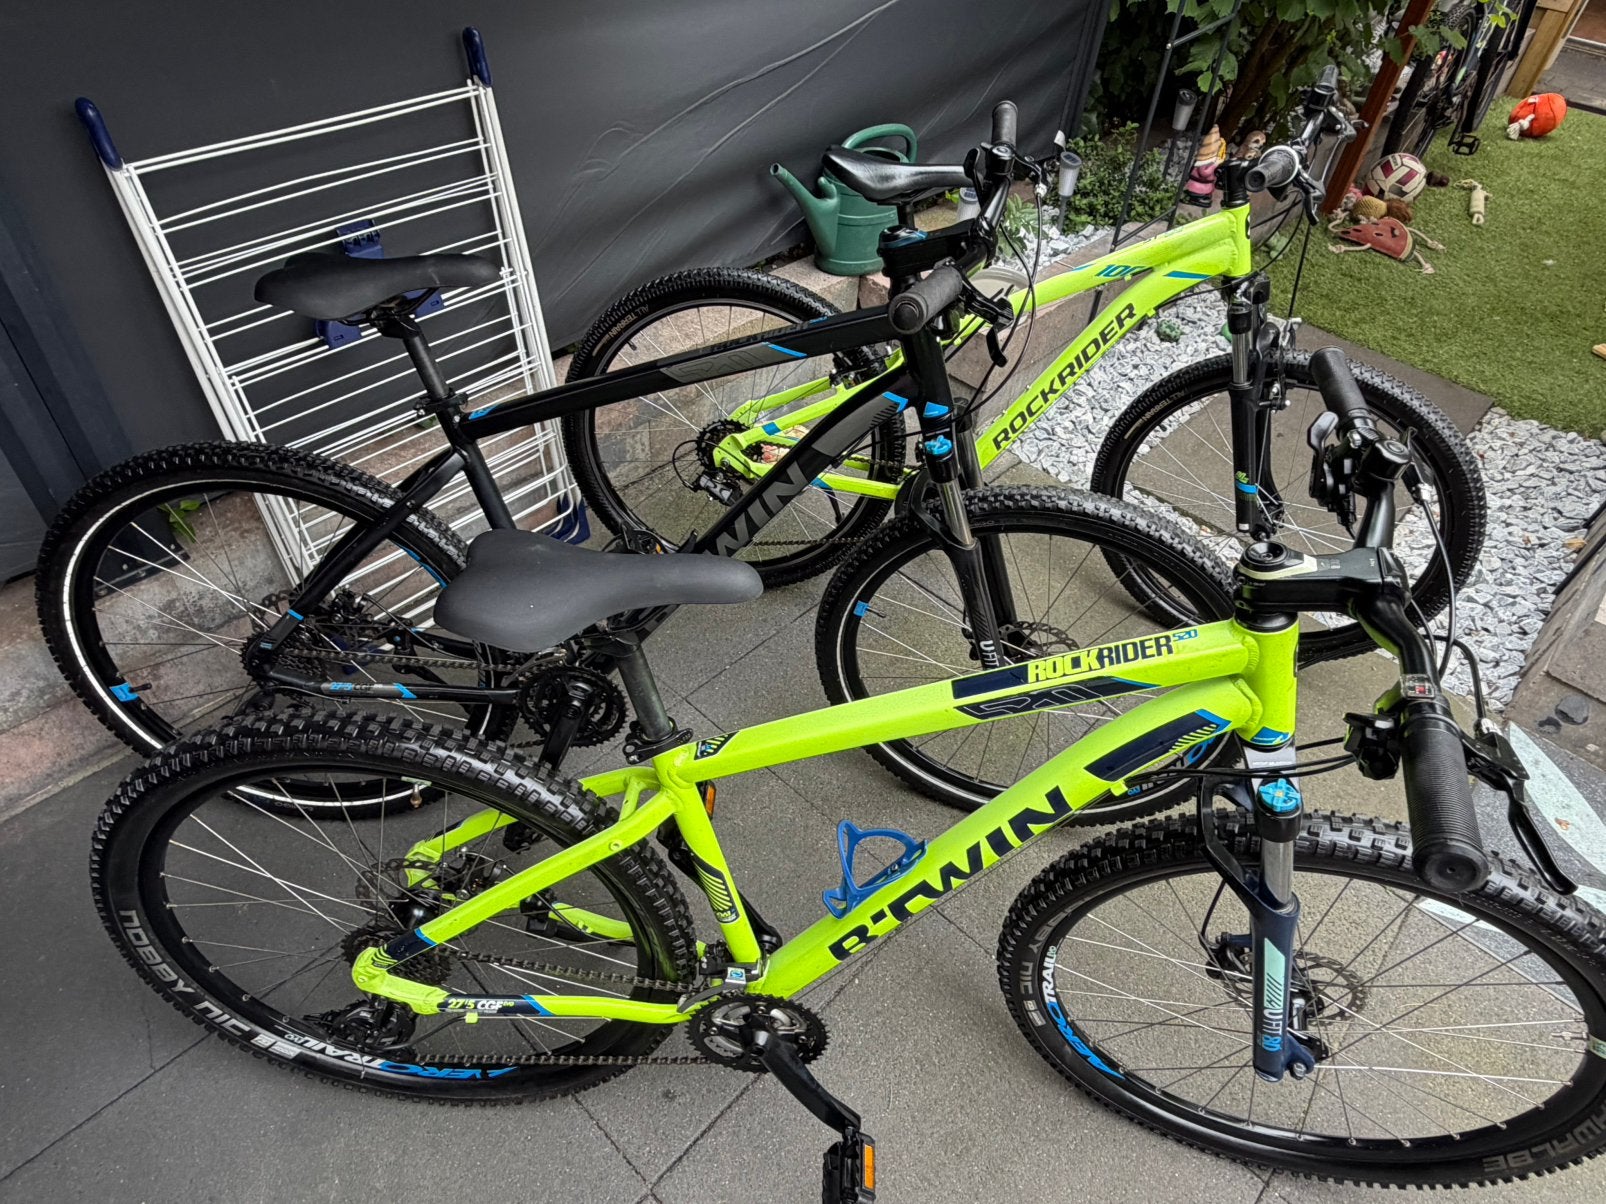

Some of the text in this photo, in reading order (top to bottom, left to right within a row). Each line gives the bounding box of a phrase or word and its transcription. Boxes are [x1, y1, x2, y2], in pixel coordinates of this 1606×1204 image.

[608, 312, 638, 338] TERRAIN
[992, 302, 1136, 450] ROCKRIDER
[1027, 628, 1198, 684] ROCKRIDER 520
[118, 909, 251, 1026] NOBBY NIC
[1019, 960, 1035, 996] NIC
[476, 999, 503, 1011] CGF
